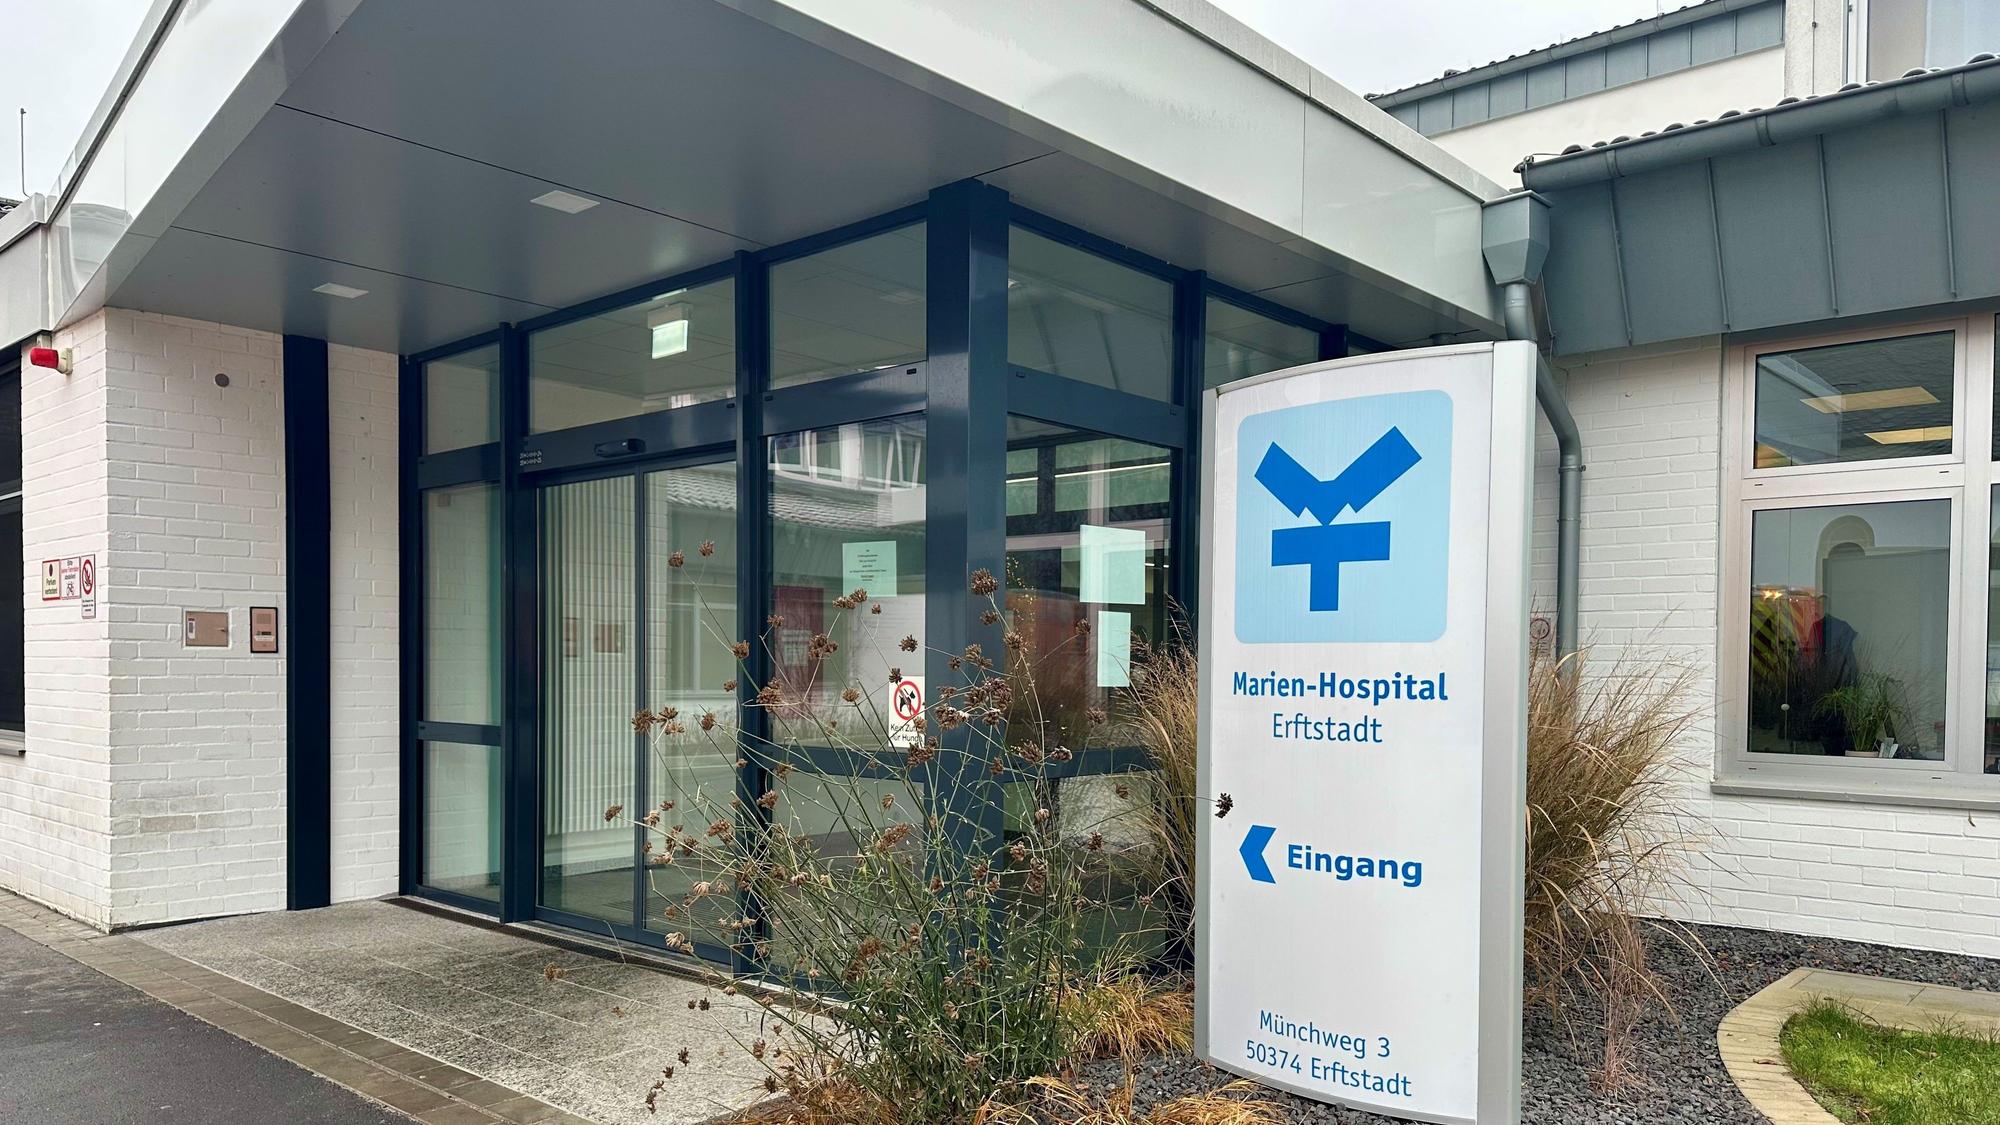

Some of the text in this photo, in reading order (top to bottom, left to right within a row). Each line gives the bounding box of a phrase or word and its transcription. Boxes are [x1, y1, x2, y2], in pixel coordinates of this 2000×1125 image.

[1233, 671, 1449, 706] Marien-Hospital
[1273, 712, 1383, 744] Erftstadt
[1287, 843, 1423, 888] Eingang
[1260, 1009, 1391, 1059] Münchweg 3
[1246, 1039, 1412, 1097] 50374 Erftstadt
